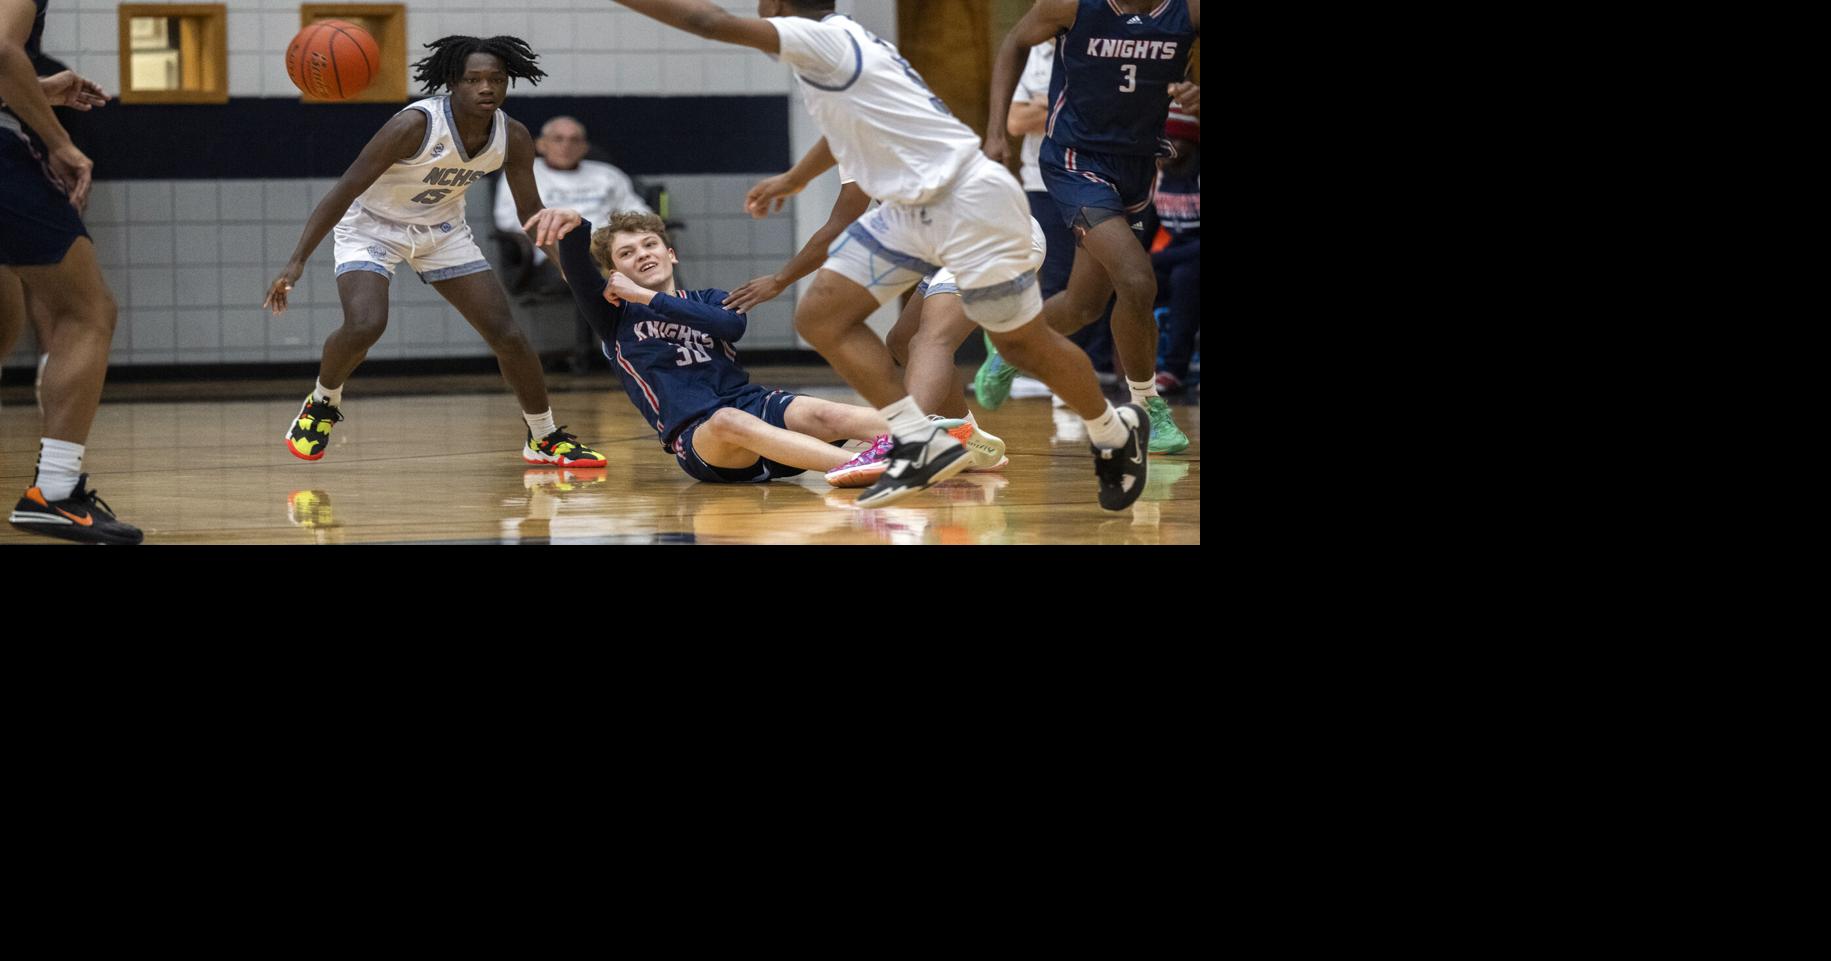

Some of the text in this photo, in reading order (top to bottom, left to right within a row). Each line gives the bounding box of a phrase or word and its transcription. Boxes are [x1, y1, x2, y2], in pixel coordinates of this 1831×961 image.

[1086, 38, 1178, 60] KNIGHTS
[1119, 64, 1137, 93] 3
[422, 166, 485, 187] NCHS
[410, 188, 453, 205] 15
[633, 320, 714, 349] KNIGHTS
